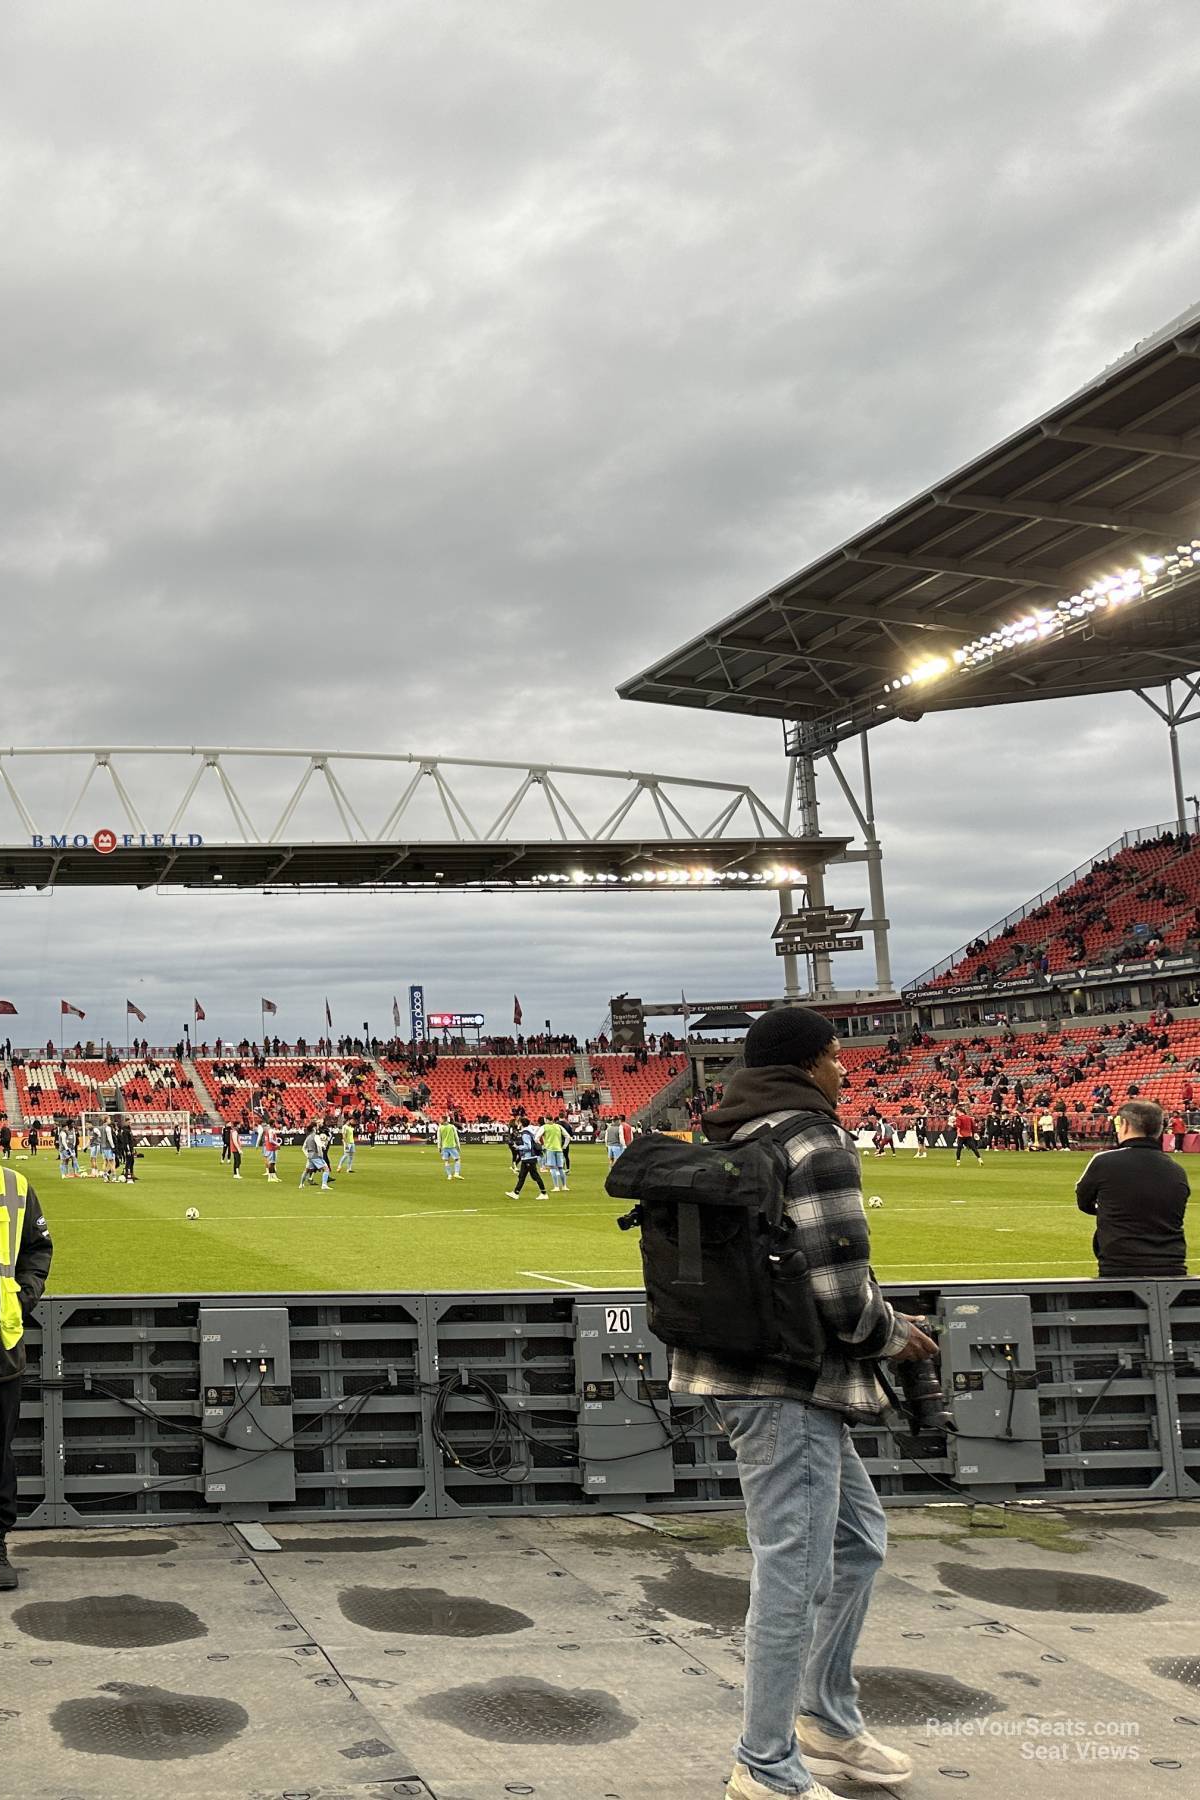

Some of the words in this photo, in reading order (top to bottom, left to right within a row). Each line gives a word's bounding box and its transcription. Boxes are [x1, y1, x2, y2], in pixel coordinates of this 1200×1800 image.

[32, 834, 88, 848] BMO
[122, 834, 203, 848] FIELD
[778, 939, 858, 953] CHEVROLET
[411, 991, 424, 1018] place
[389, 1133, 411, 1141] CASINO
[607, 1309, 630, 1332] 20
